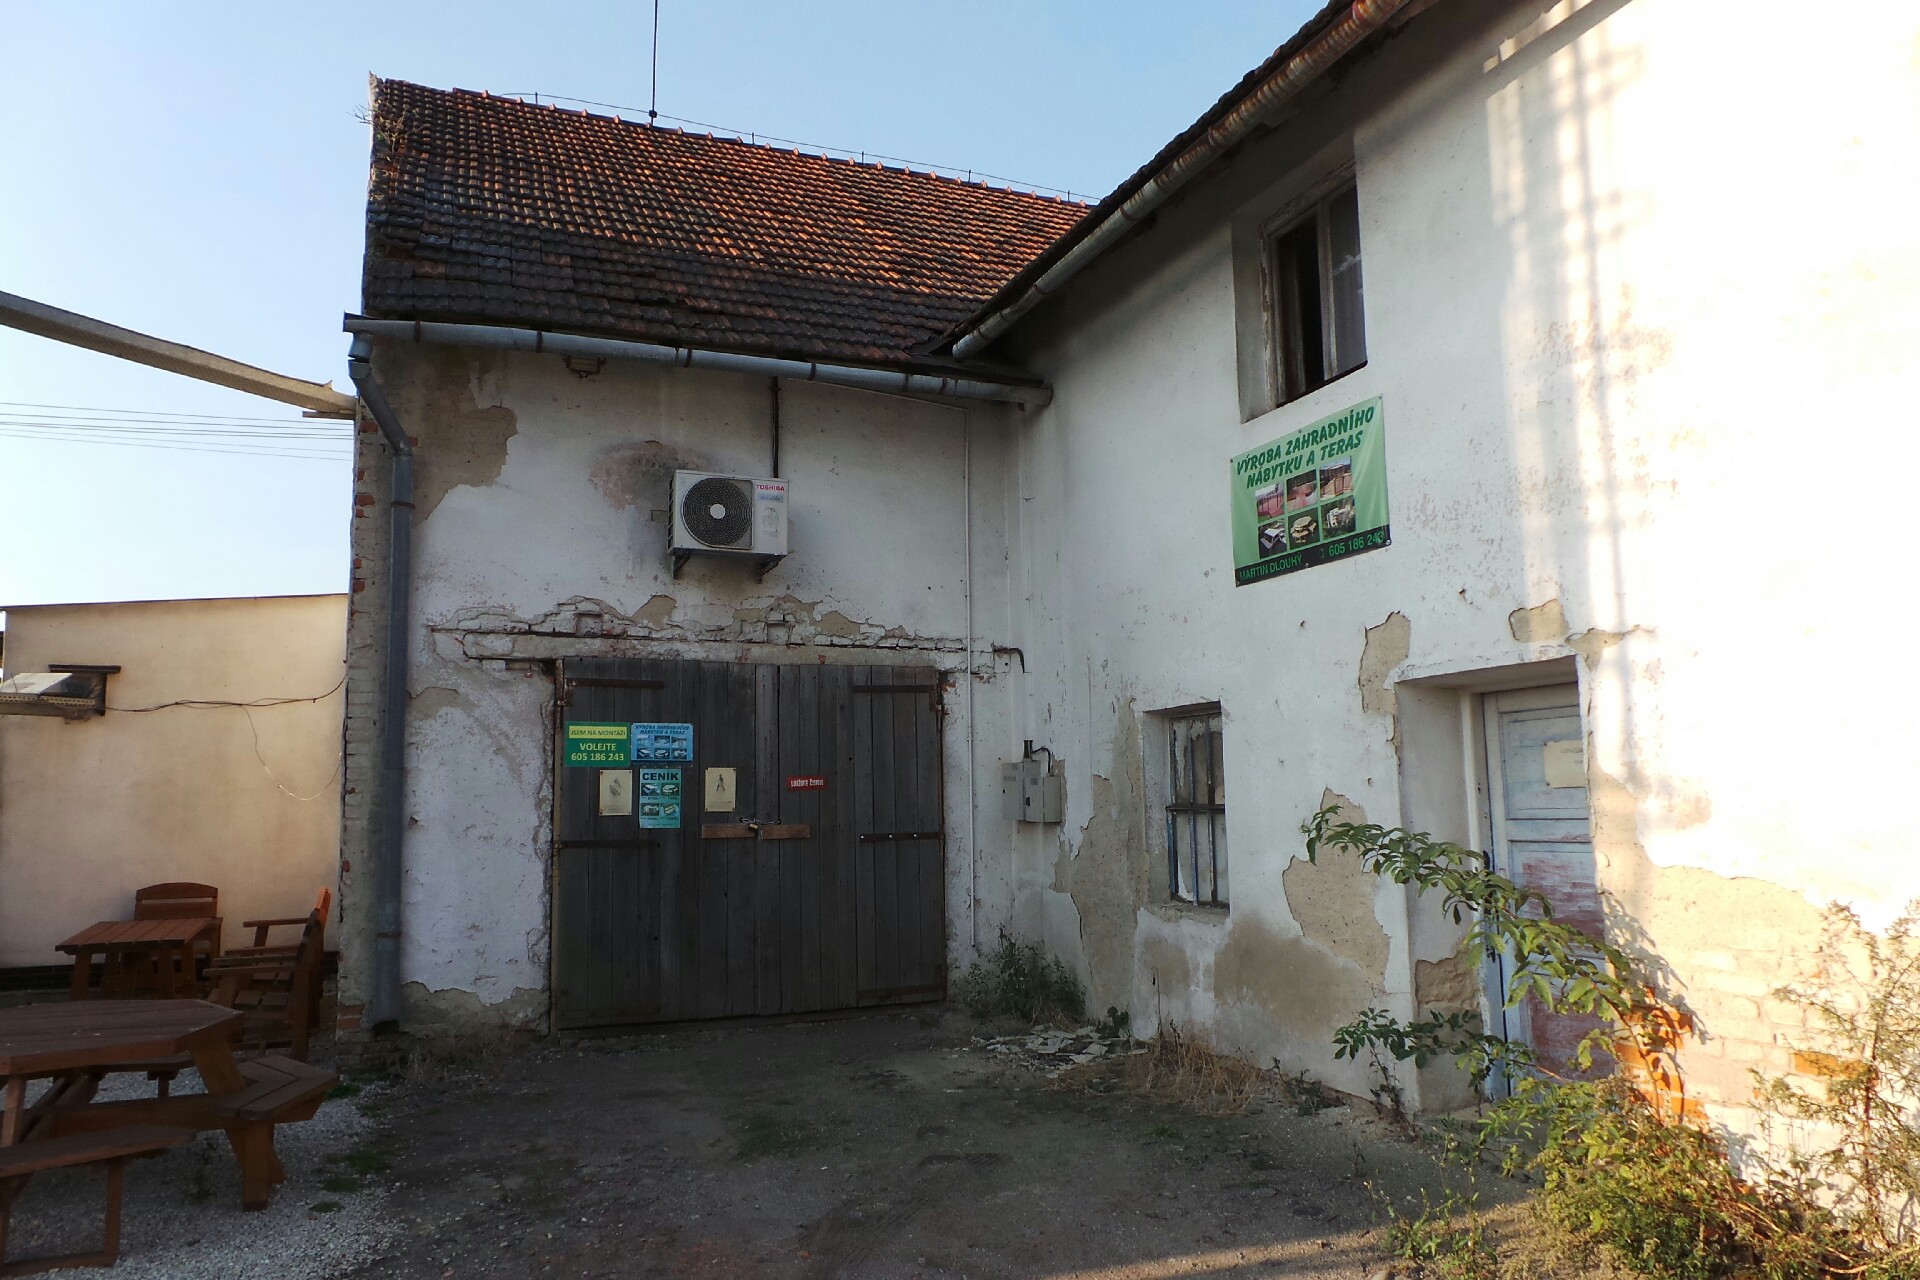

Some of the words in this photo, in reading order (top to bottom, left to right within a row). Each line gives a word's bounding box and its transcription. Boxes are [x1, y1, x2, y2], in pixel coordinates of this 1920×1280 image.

[1236, 445, 1281, 475] VÝROBA
[1286, 406, 1374, 456] ZAHRADNÍHO
[1246, 454, 1303, 489] NÁBYTKU
[1306, 449, 1315, 467] A
[1320, 430, 1364, 461] TERAS
[756, 484, 785, 492] TOSHIBA
[1328, 541, 1346, 557] 605
[1348, 537, 1365, 551] 186
[1367, 530, 1385, 546] 243
[1239, 564, 1269, 581] MARTIN
[579, 742, 617, 751] VOLEJTE
[571, 753, 588, 761] 605
[590, 752, 606, 761] 186
[607, 753, 624, 761] 243
[642, 770, 679, 781] CENÍK
